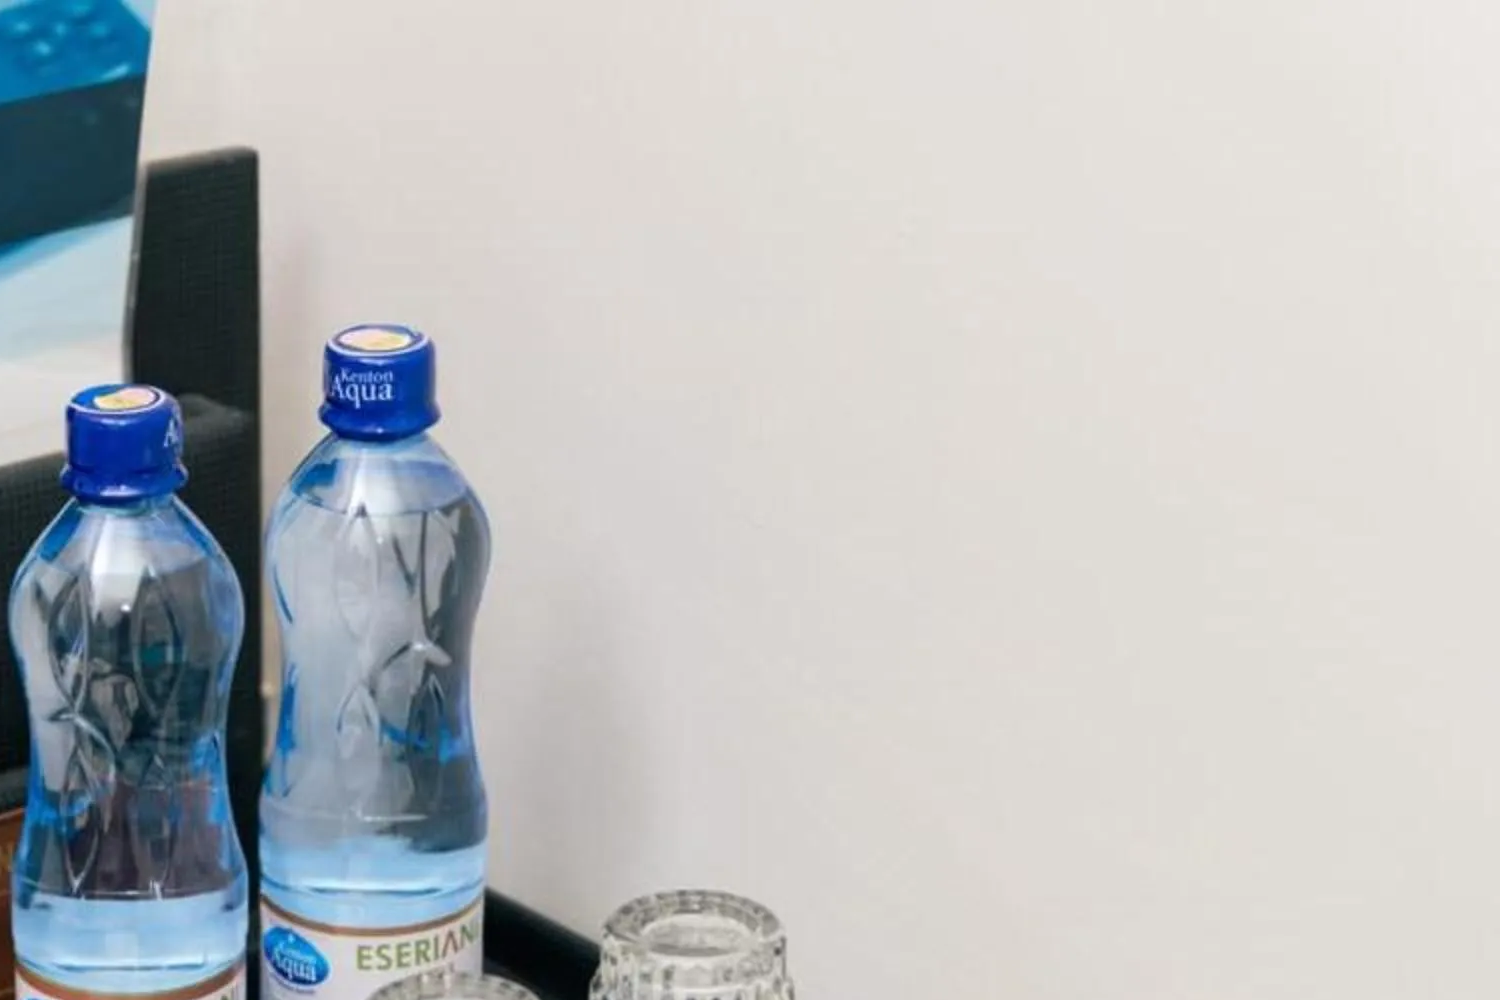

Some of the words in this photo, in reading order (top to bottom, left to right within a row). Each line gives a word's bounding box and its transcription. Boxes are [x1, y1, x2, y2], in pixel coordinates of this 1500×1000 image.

[331, 373, 393, 409] Aqua
[340, 367, 394, 384] Kenton
[273, 945, 317, 982] Aqua
